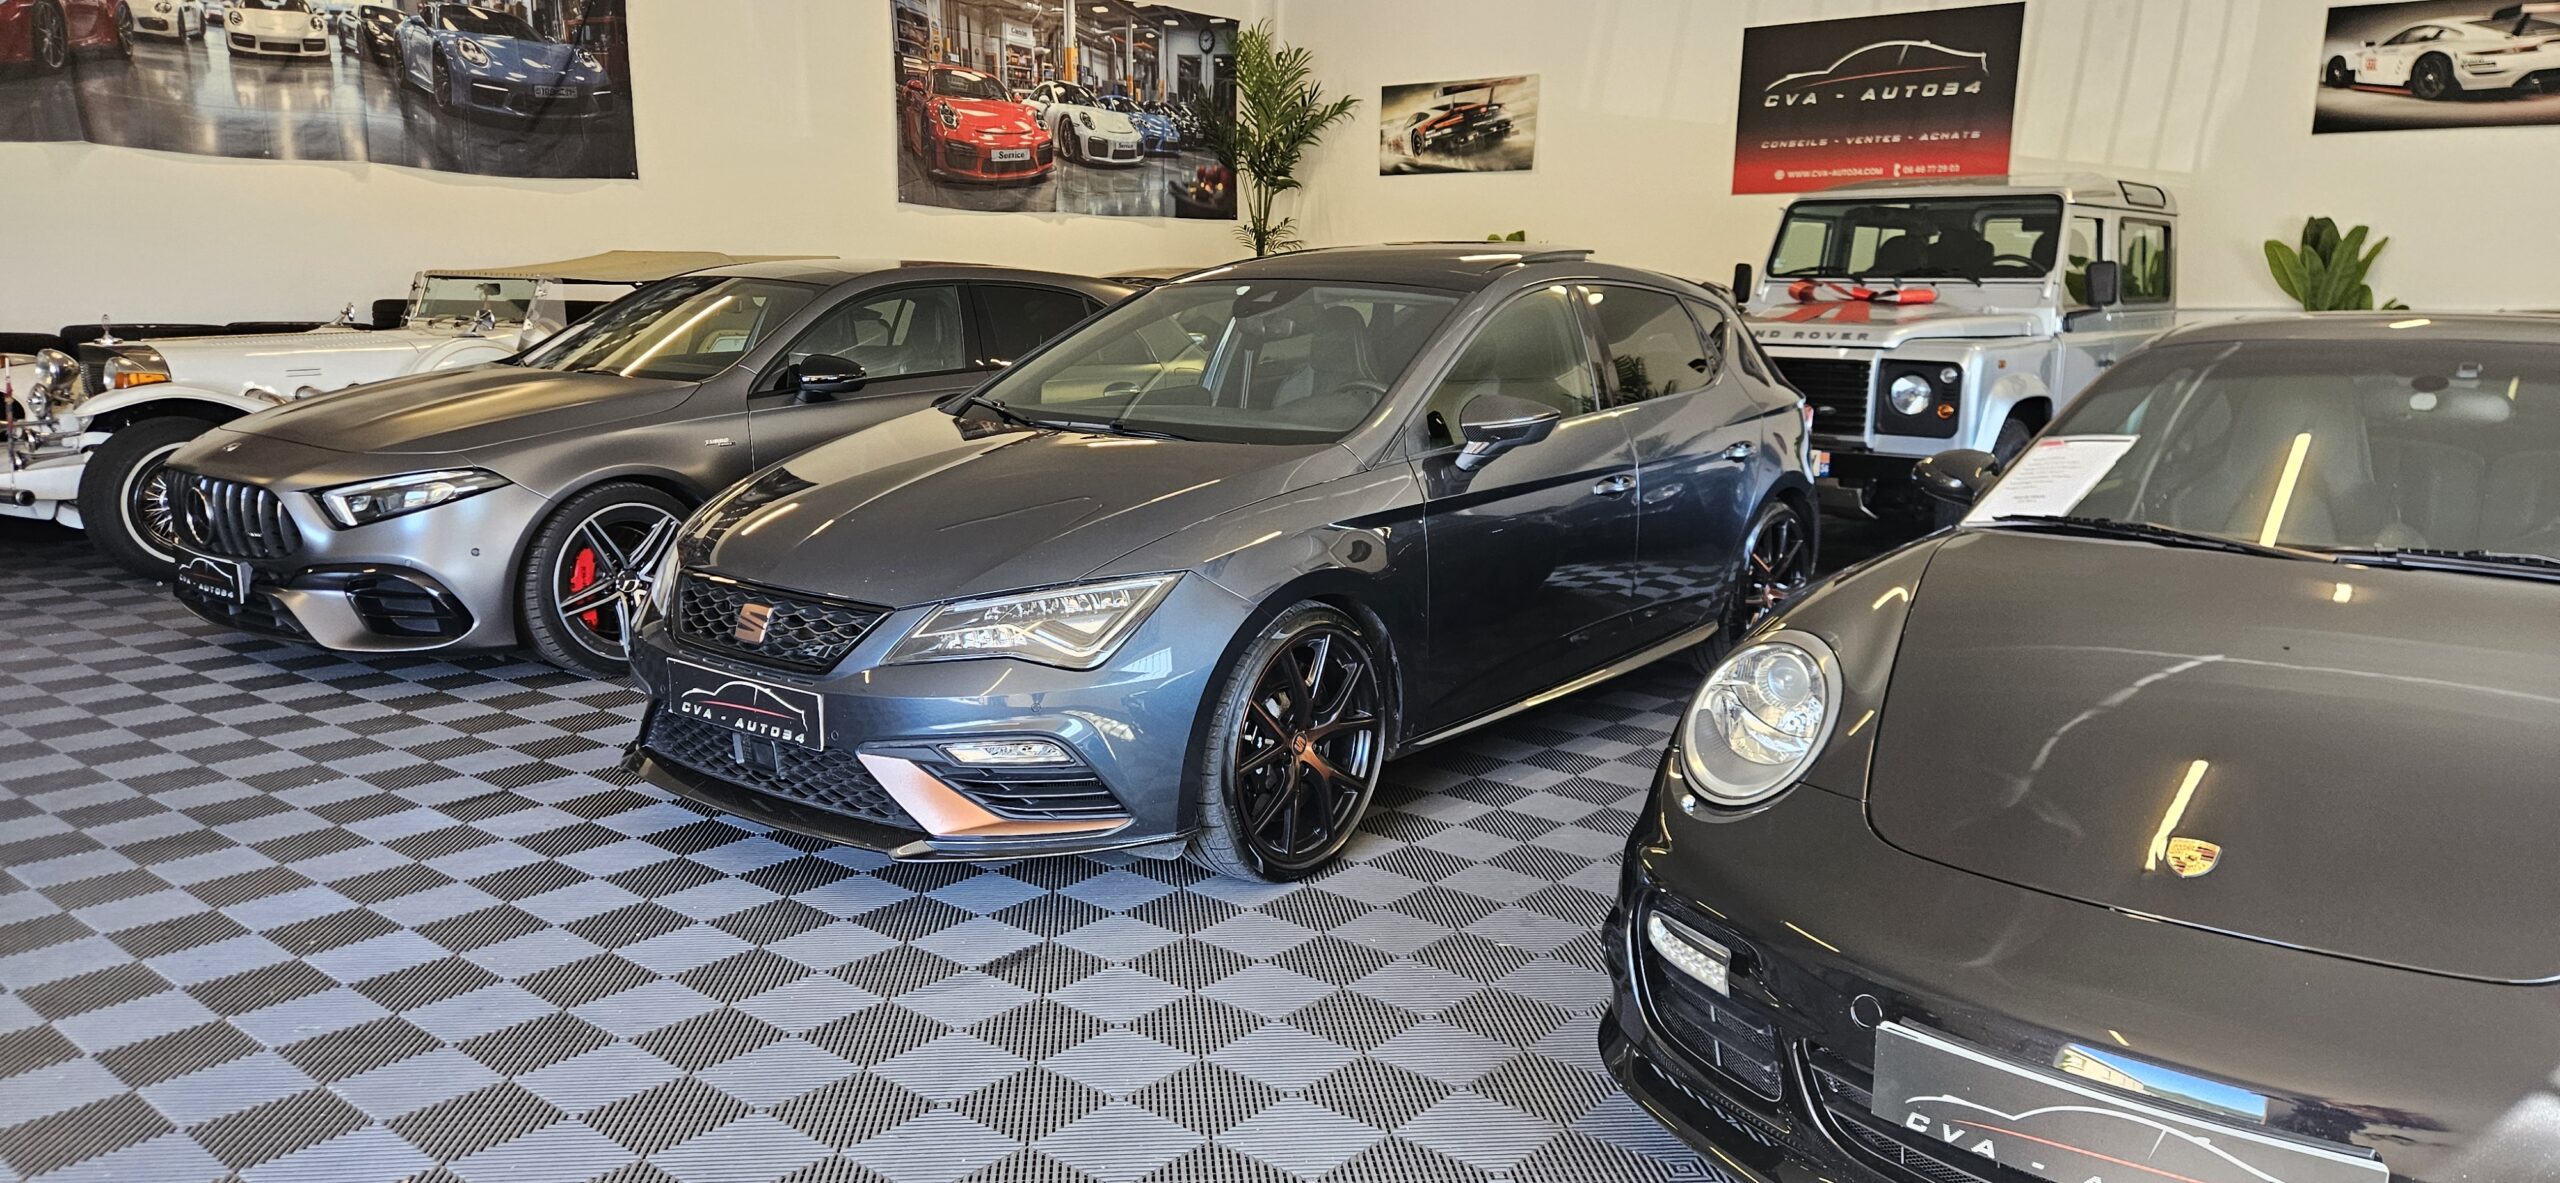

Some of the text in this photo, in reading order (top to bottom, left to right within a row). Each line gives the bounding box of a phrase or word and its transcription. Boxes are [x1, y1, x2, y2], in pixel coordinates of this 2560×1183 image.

[1764, 92, 1817, 108] CVA
[1861, 81, 1982, 101] AUTO34
[1760, 138, 1828, 149] CONSEILS
[1845, 134, 1902, 145] VENTES
[1918, 130, 1982, 142] ACHATS
[1754, 330, 1869, 340] ND ROVER
[681, 701, 712, 720] CVA
[734, 717, 806, 744] AUTO34
[1905, 1111, 1996, 1160] CVA
